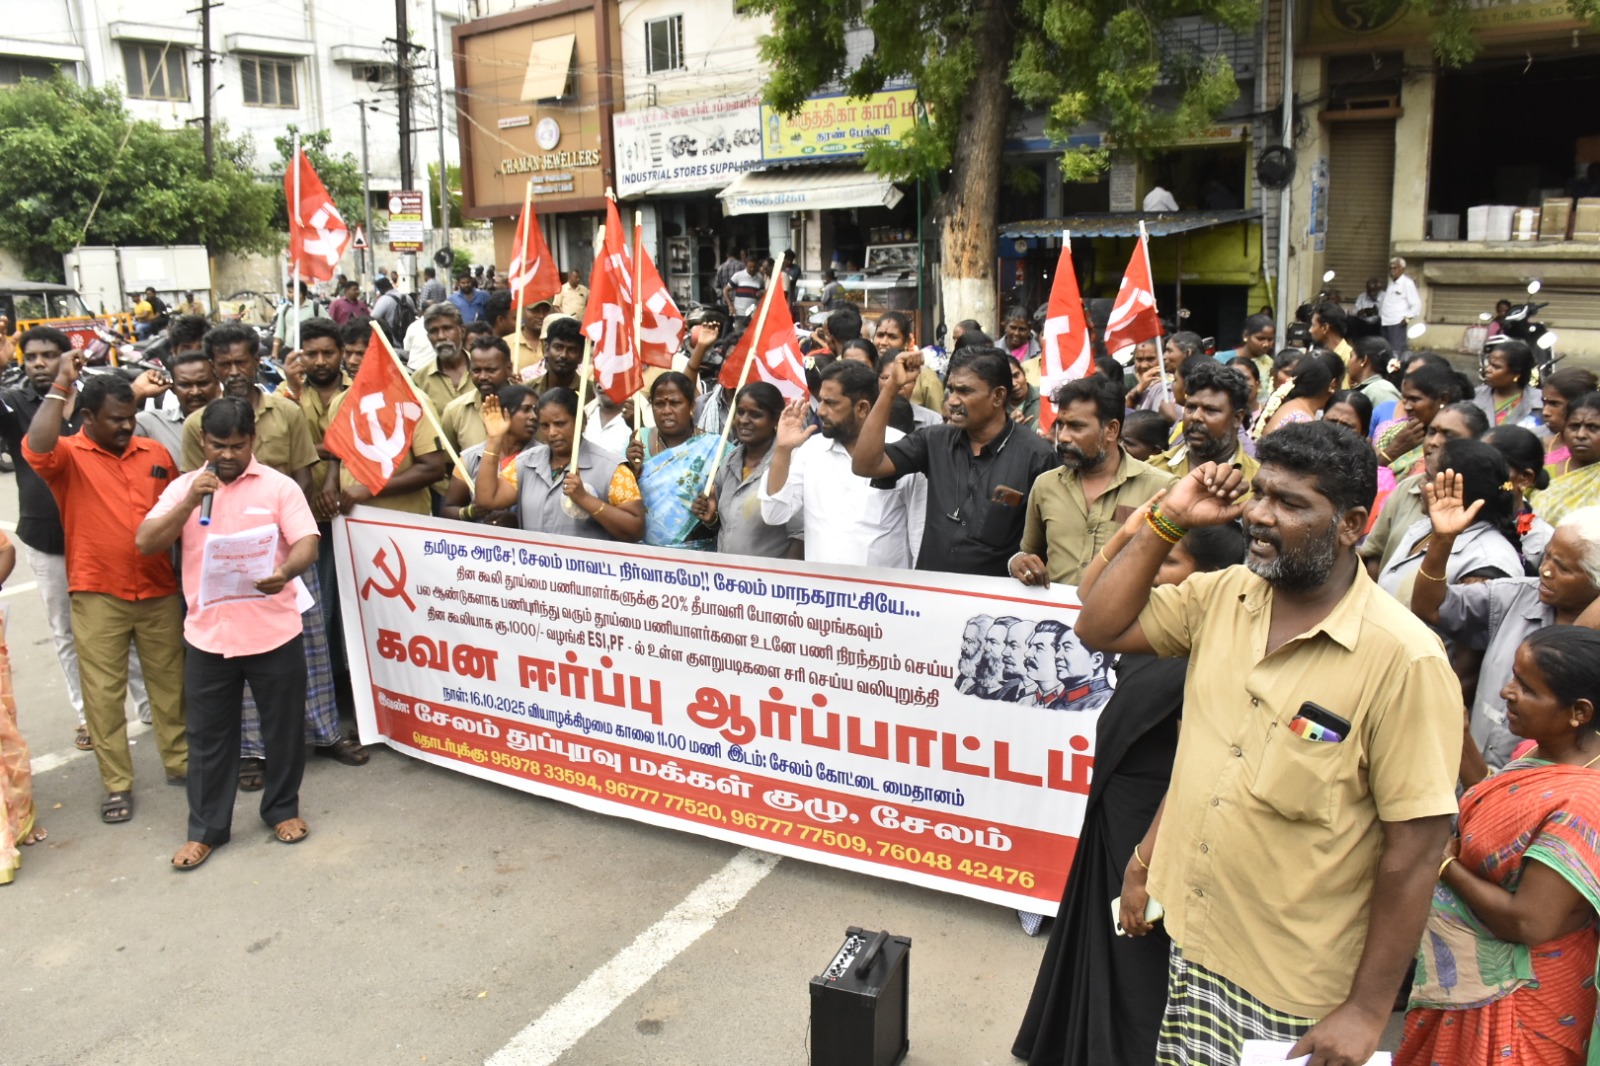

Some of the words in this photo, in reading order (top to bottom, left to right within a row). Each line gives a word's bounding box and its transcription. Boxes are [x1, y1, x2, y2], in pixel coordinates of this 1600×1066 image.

[861, 97, 897, 120] காபி
[501, 156, 540, 174] CHAMAN
[541, 149, 600, 170] JEWELLERS
[621, 171, 672, 185] INDUSTRIAL
[673, 165, 707, 179] STORES
[710, 159, 762, 175] SUPPLIERS
[424, 539, 467, 561] தமிழக
[471, 545, 516, 566] அரசே!
[519, 548, 562, 570] சேலம்
[566, 558, 617, 577] மாவட்ட
[620, 562, 709, 591] நிர்வாகமே!!
[714, 572, 767, 596] சேலம்
[771, 583, 920, 618] மாநகராட்சியே...
[457, 566, 475, 581] தின
[478, 570, 502, 585] கூலி
[505, 574, 547, 590] தூய்மை
[550, 581, 658, 609] பணியாளர்களுக்கு
[661, 594, 688, 612] 20%
[691, 595, 744, 620] தீபாவளி
[747, 605, 803, 628] போனஸ்
[807, 617, 883, 641] வழங்கவும்
[416, 584, 430, 596] பல
[433, 587, 499, 608] ஆண்டுகளாக
[501, 598, 560, 621] பணிபுரிந்து
[562, 607, 591, 624] வரும்
[595, 611, 641, 630] தூய்மை
[644, 619, 747, 647] பணியாளர்களை
[751, 634, 796, 654] உடனே
[799, 643, 833, 660] பணி
[837, 646, 901, 671] நிரந்தரம்
[905, 658, 953, 679] செய்ய
[427, 606, 446, 621] தின
[448, 612, 493, 629] கூலியாக
[495, 619, 544, 643] ரூ.1000/-
[547, 628, 585, 646] வழங்கி
[588, 631, 624, 653] ESI,PF
[648, 643, 683, 661] உள்ள
[686, 651, 780, 679] குளறுபடிகளை
[784, 666, 806, 683] சரி
[809, 670, 853, 691] செய்ய
[857, 679, 940, 708] வலியுறுத்தி
[375, 627, 498, 682] கவன
[518, 650, 664, 726] ஈர்ப்பு
[686, 684, 1095, 796] ஆர்ப்பாட்டம்
[443, 687, 469, 704] நாள்:
[469, 691, 526, 717] 16.10.2025
[529, 704, 613, 736] வியாழக்கிழமை
[615, 724, 655, 744] காலை
[656, 732, 687, 752] 11.00
[689, 740, 722, 760] மணி
[727, 743, 768, 769] இடம்:
[770, 758, 813, 779] சேலம்
[816, 762, 880, 793] கோட்டை
[882, 780, 965, 807] மைதானம்
[412, 729, 489, 763] தொடர்புக்கு:
[491, 751, 541, 776] 95978
[543, 764, 603, 794] 33594,
[605, 779, 659, 806] 96777
[662, 792, 727, 823] 77520,
[730, 810, 794, 837] 96777
[796, 823, 872, 857] 77509,
[876, 840, 952, 872] 76048
[957, 858, 1036, 890] 42476
[414, 703, 500, 739] சேலம்
[506, 728, 622, 773] துப்புரவு
[629, 759, 754, 799] மக்கள்
[762, 788, 860, 824] குழு,
[870, 804, 1013, 852] சேலம்
